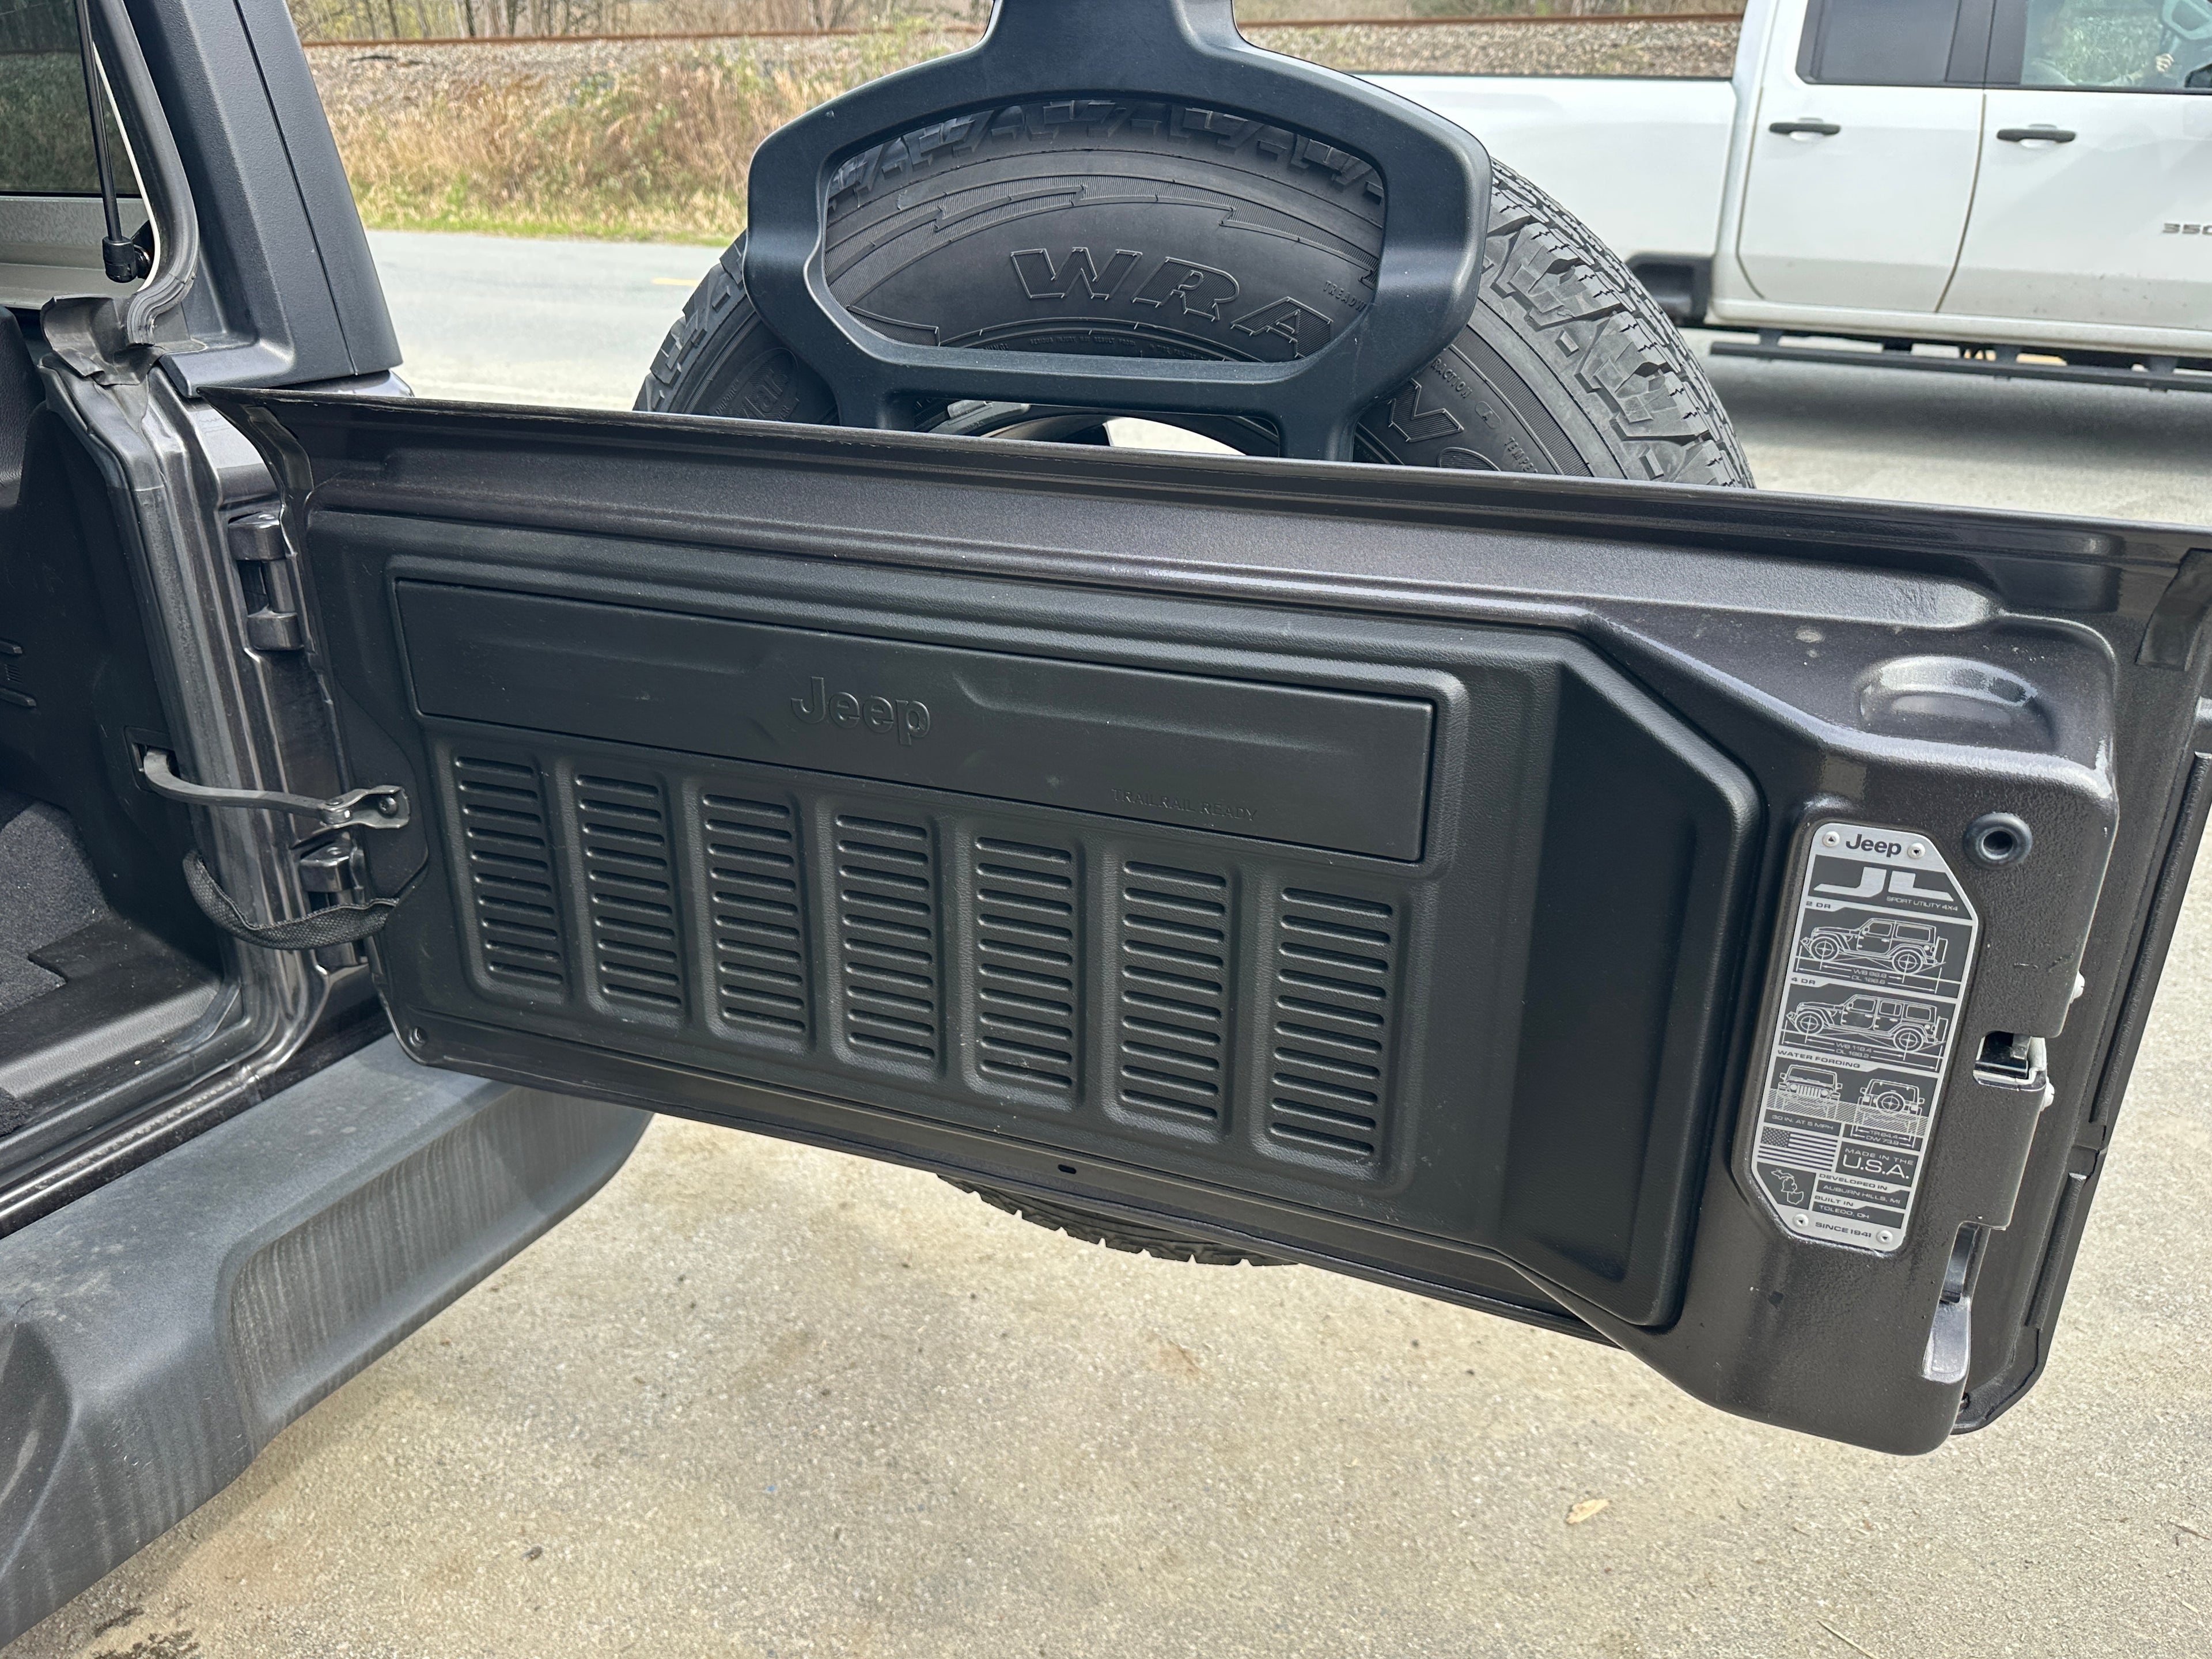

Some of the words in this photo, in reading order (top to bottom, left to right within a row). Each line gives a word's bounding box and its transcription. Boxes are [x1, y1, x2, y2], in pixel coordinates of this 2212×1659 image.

[1430, 358, 1473, 399] RACTION
[790, 676, 930, 746] Jeep
[1200, 802, 1257, 821] READY
[1846, 834, 1902, 858] Jeep
[1813, 866, 1954, 902] JL
[1887, 896, 1912, 904] SPORT
[1913, 900, 1941, 909] UTILITY
[1778, 1050, 1813, 1060] WATER
[1815, 1056, 1861, 1068] FORDING
[1845, 1147, 1876, 1158] MADE
[1893, 1157, 1914, 1165] THE
[1843, 1154, 1910, 1179] U.S.A.
[1819, 1173, 1876, 1188] DEVELOPED
[1815, 1195, 1842, 1204] BUILT
[1823, 1184, 1861, 1196] AUBURN
[1861, 1193, 1888, 1202] HILLS,
[1819, 1205, 1855, 1217] TOLEDO,
[1815, 1222, 1849, 1233] SINCE
[1850, 1229, 1872, 1238] 1941
